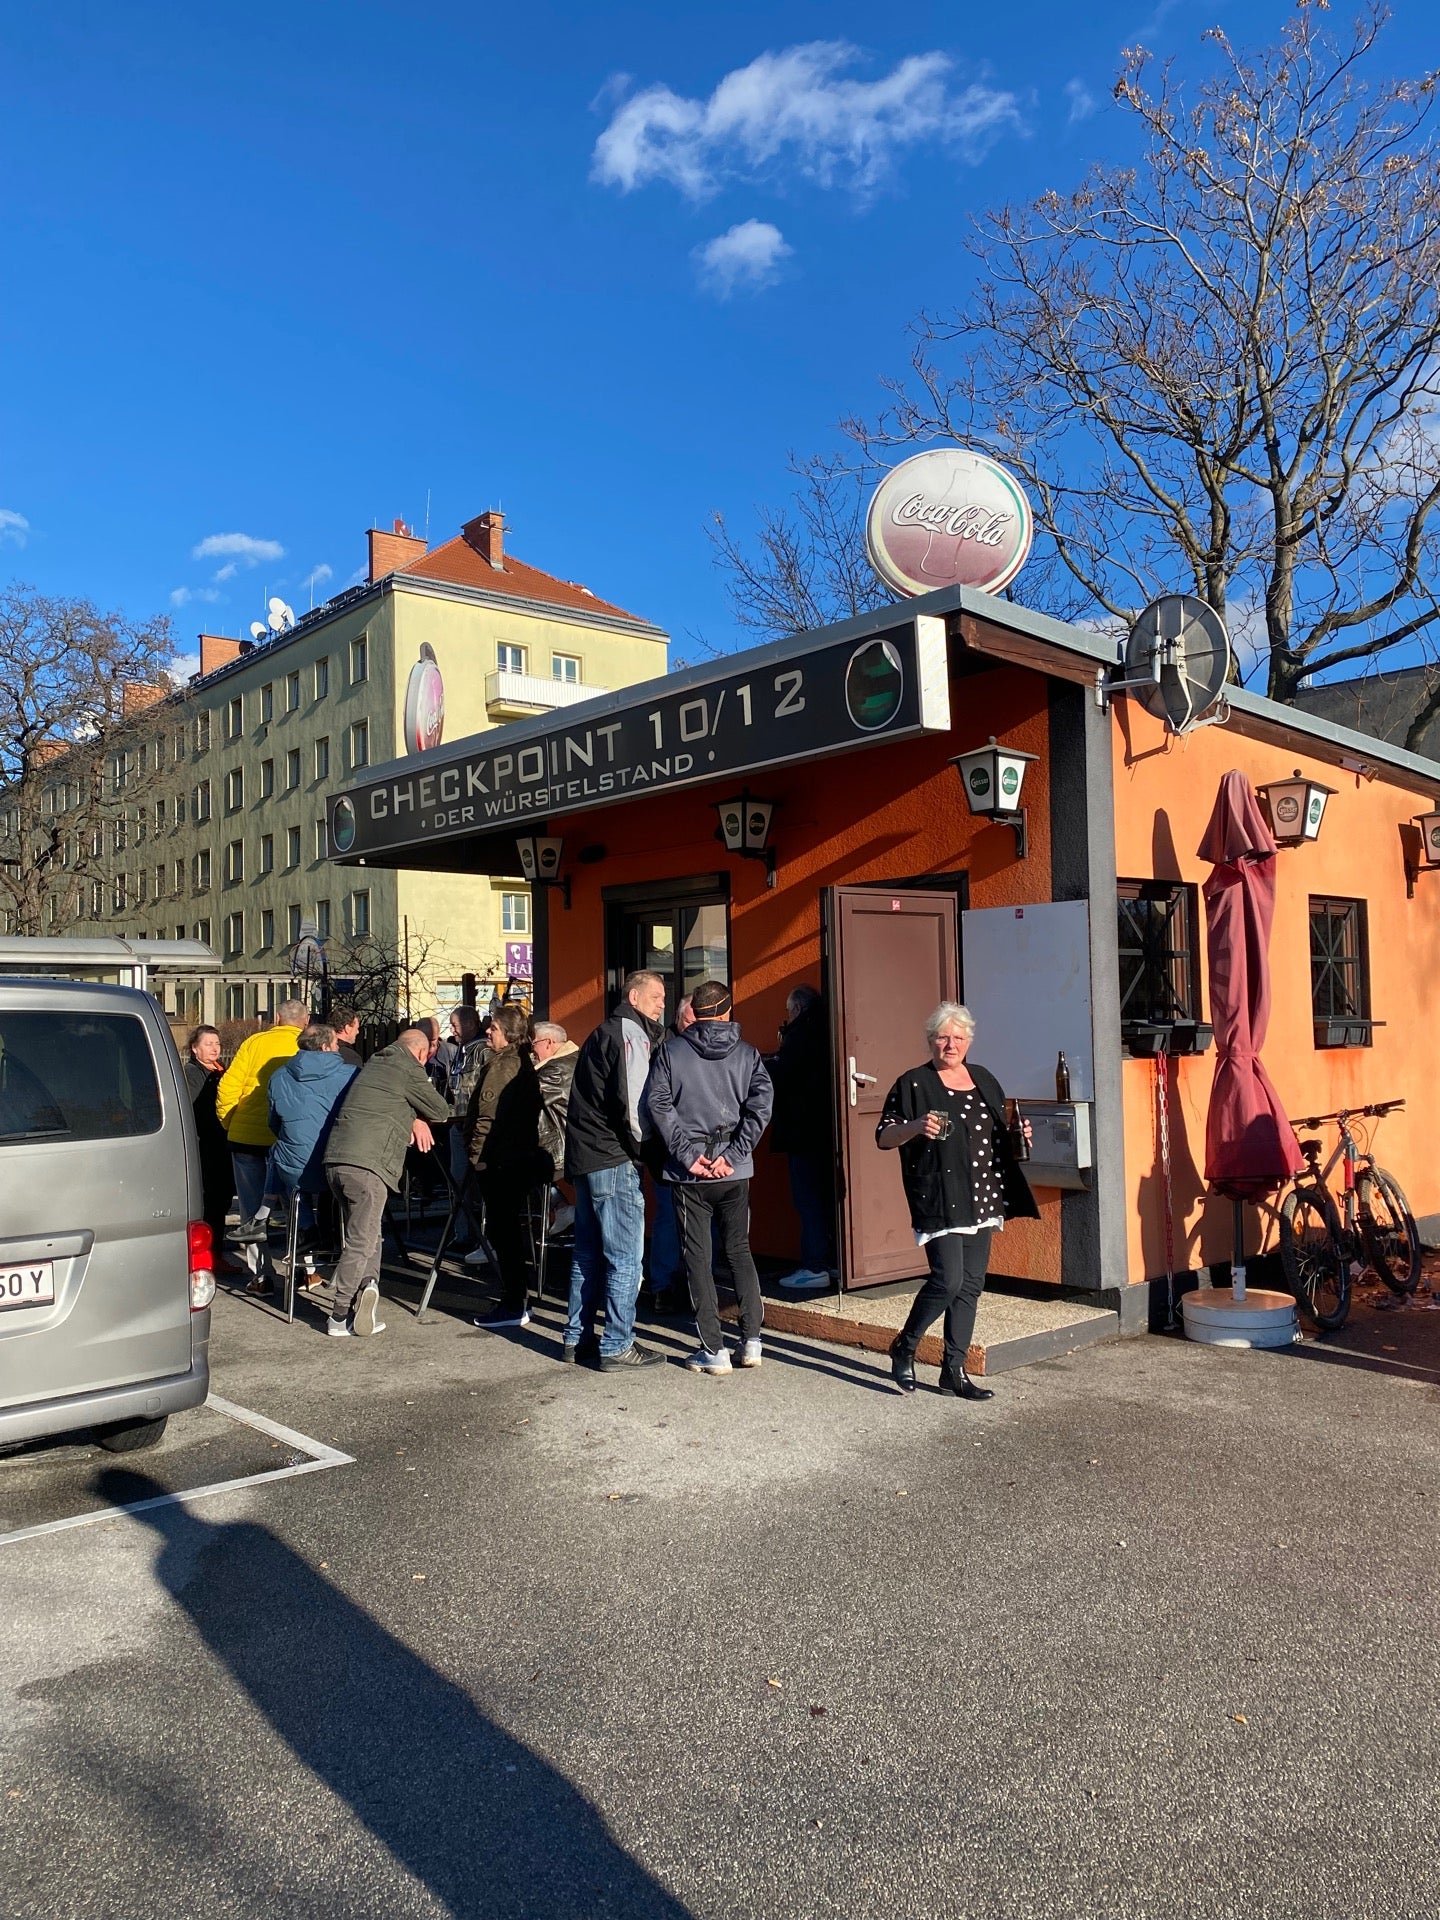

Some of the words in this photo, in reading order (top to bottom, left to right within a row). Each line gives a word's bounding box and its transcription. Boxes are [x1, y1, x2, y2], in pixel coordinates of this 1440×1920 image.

[892, 492, 1014, 546] Coca-Cola
[370, 722, 622, 820] CHECKPOINT
[649, 669, 806, 750] 10/12
[434, 805, 475, 829] DER
[485, 753, 694, 817] WÜRSTELSTAND
[30, 1269, 43, 1294] Y
